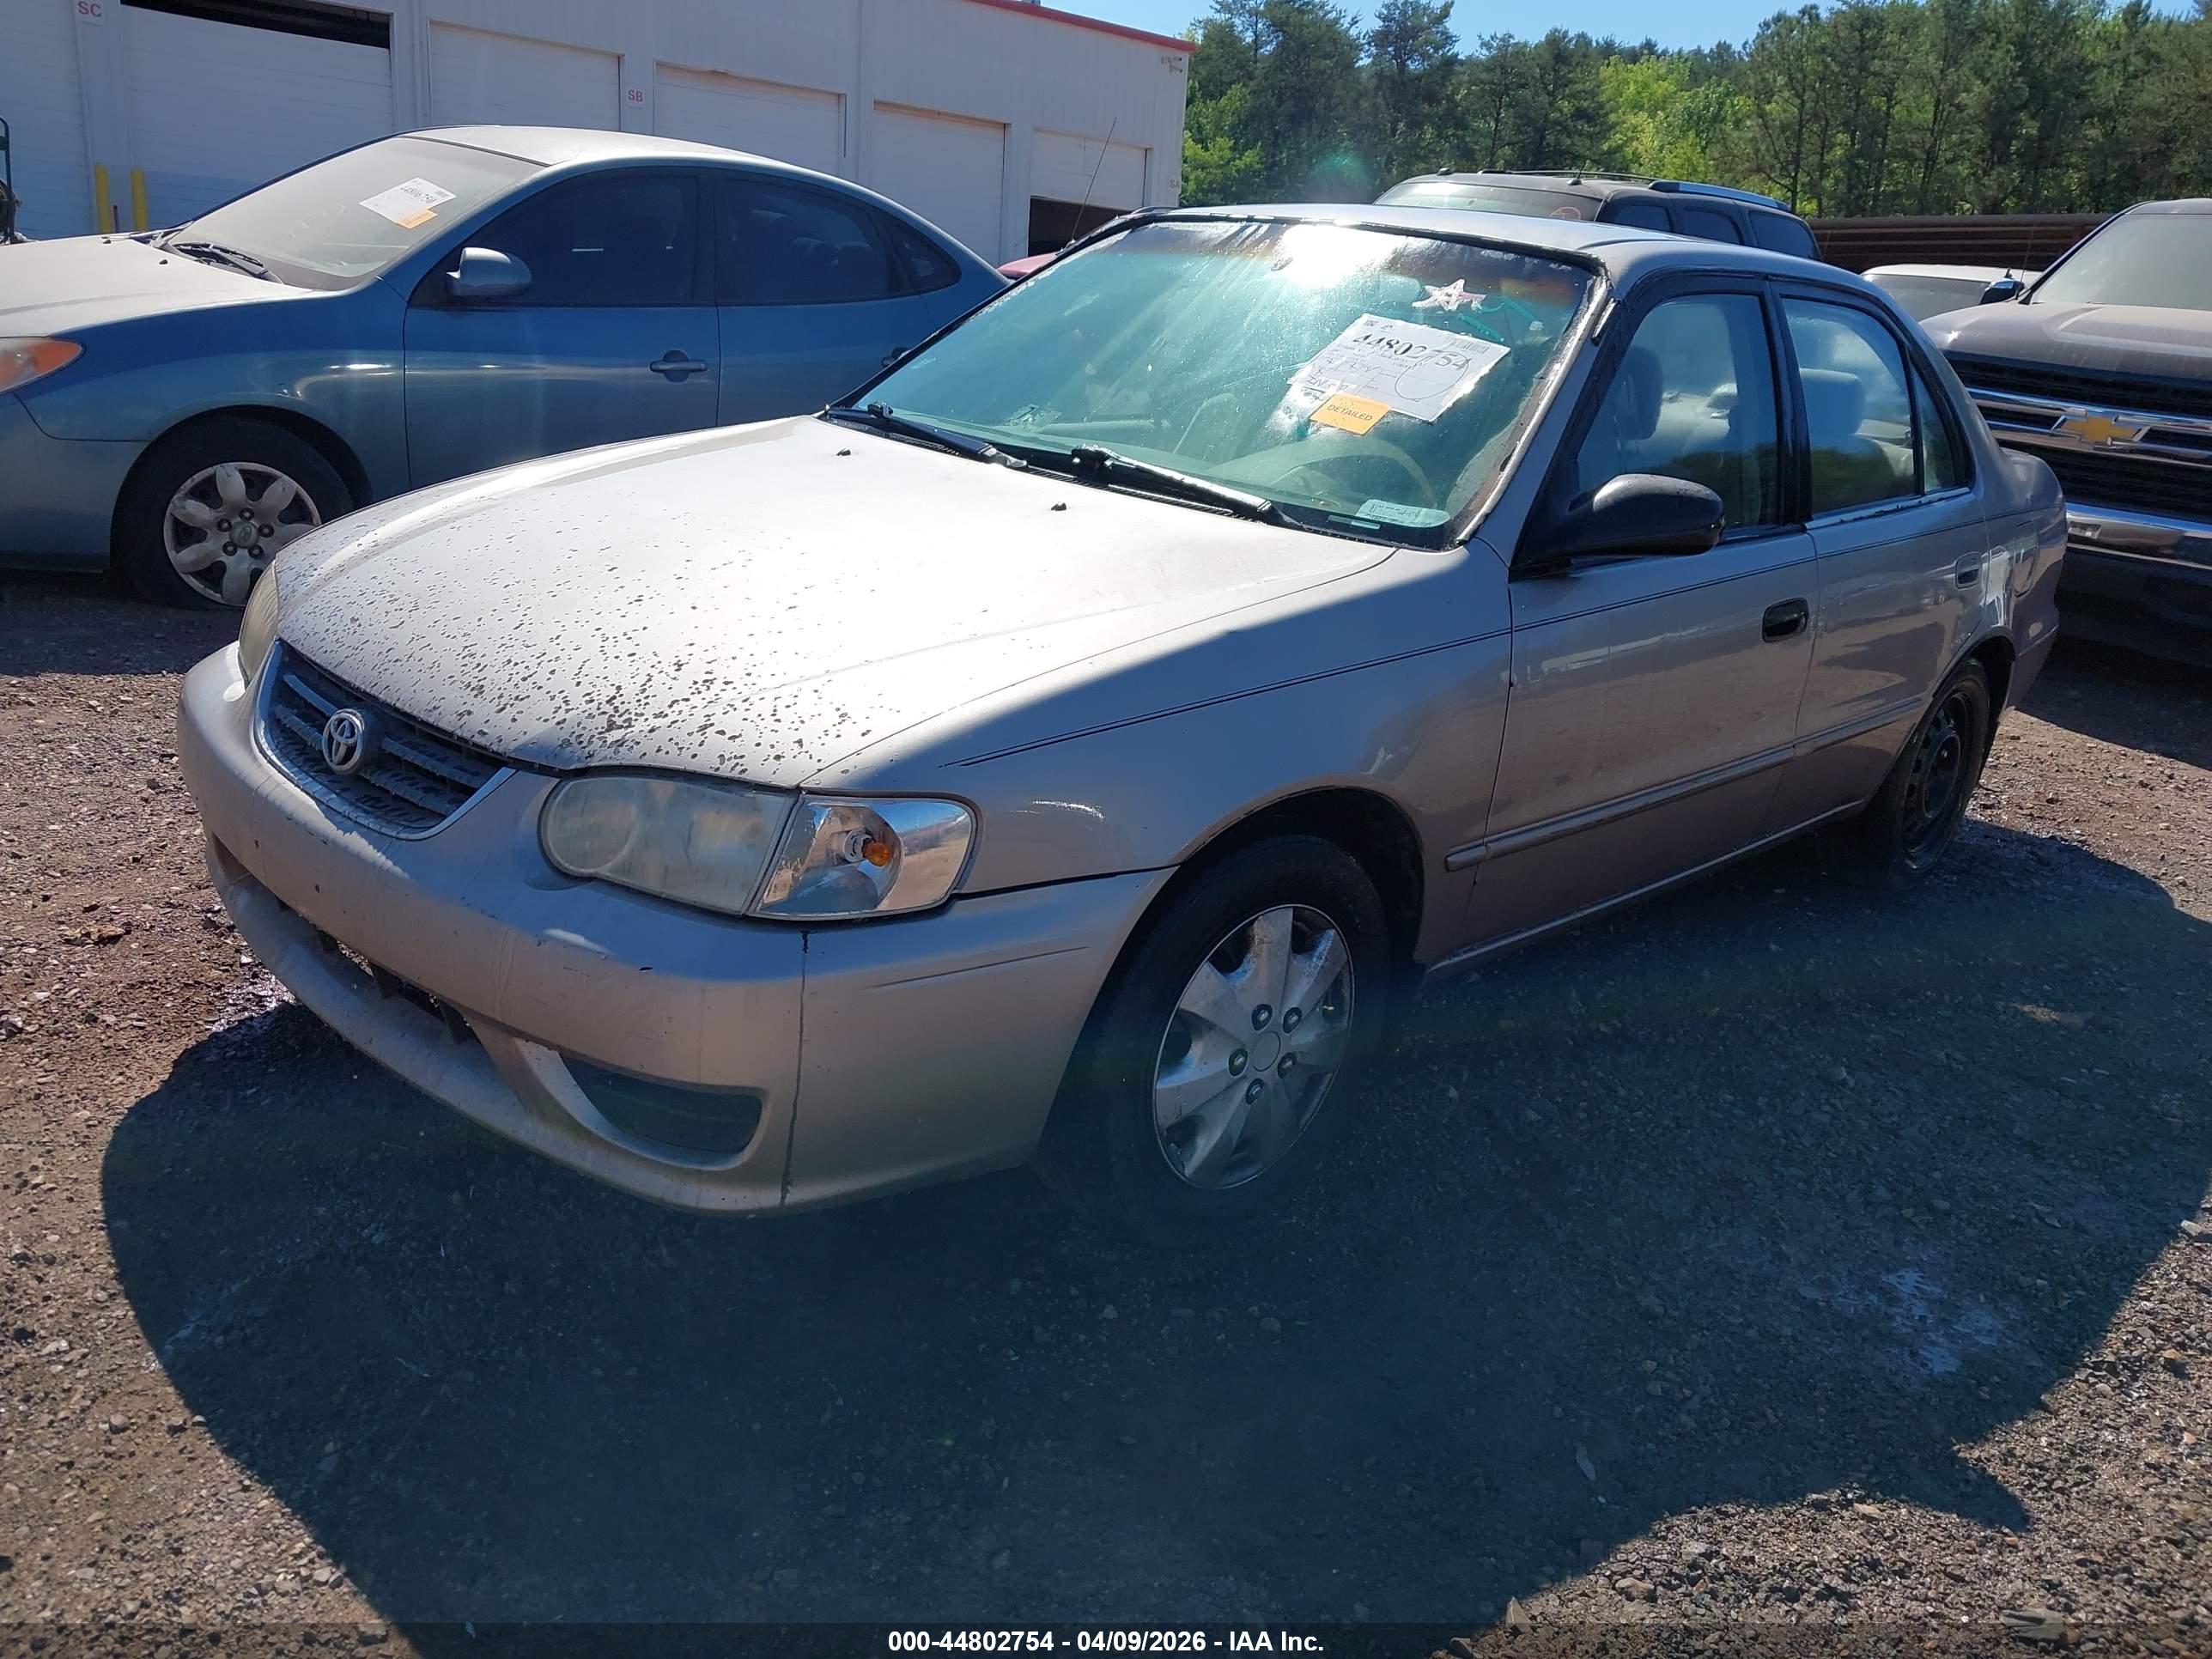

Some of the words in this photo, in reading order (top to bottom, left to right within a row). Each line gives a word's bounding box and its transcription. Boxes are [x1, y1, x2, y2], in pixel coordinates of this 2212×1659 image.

[78, 1, 101, 17] SC
[628, 89, 643, 102] SB
[1352, 333, 1472, 369] 44802754
[1327, 404, 1373, 422] DETAILED
